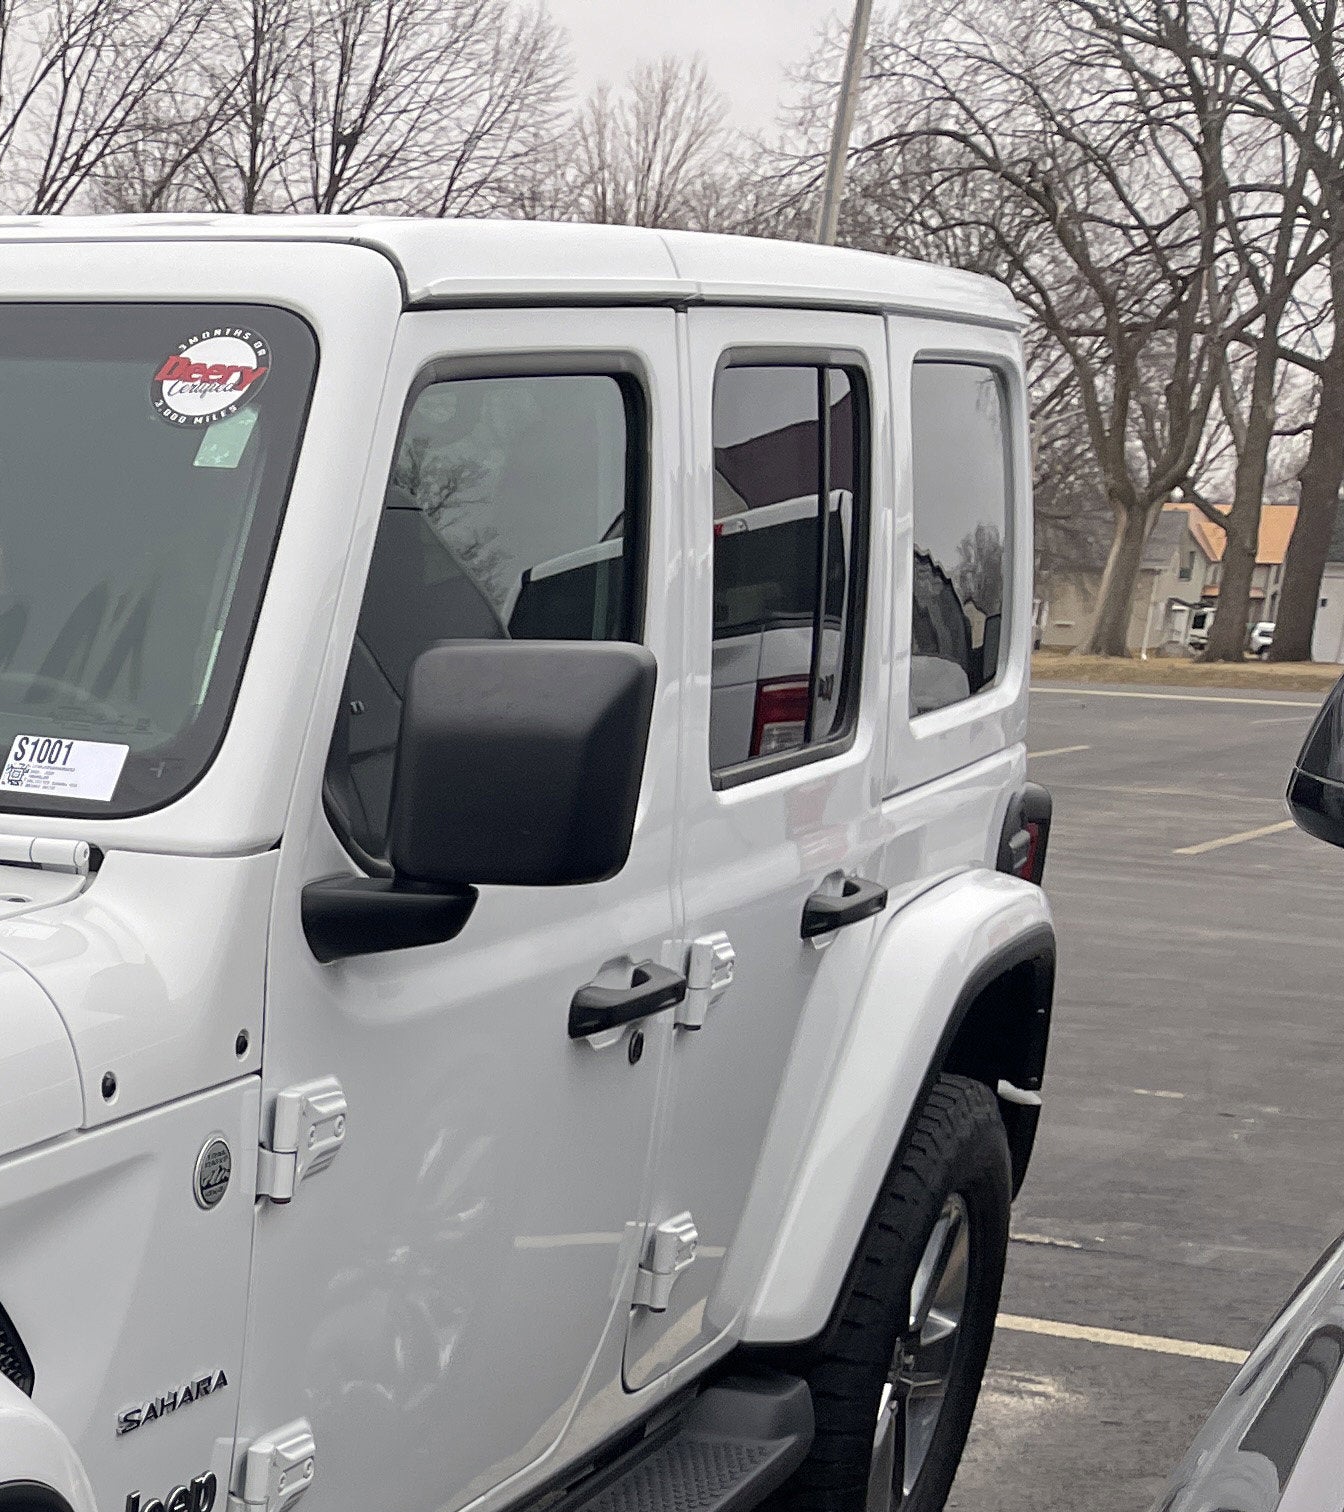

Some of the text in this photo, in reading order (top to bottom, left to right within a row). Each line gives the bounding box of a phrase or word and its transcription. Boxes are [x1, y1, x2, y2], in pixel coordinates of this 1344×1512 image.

[154, 355, 268, 391] Deery
[193, 405, 238, 425] MILES
[14, 736, 74, 766] S1001
[116, 1369, 228, 1436] SAHARA
